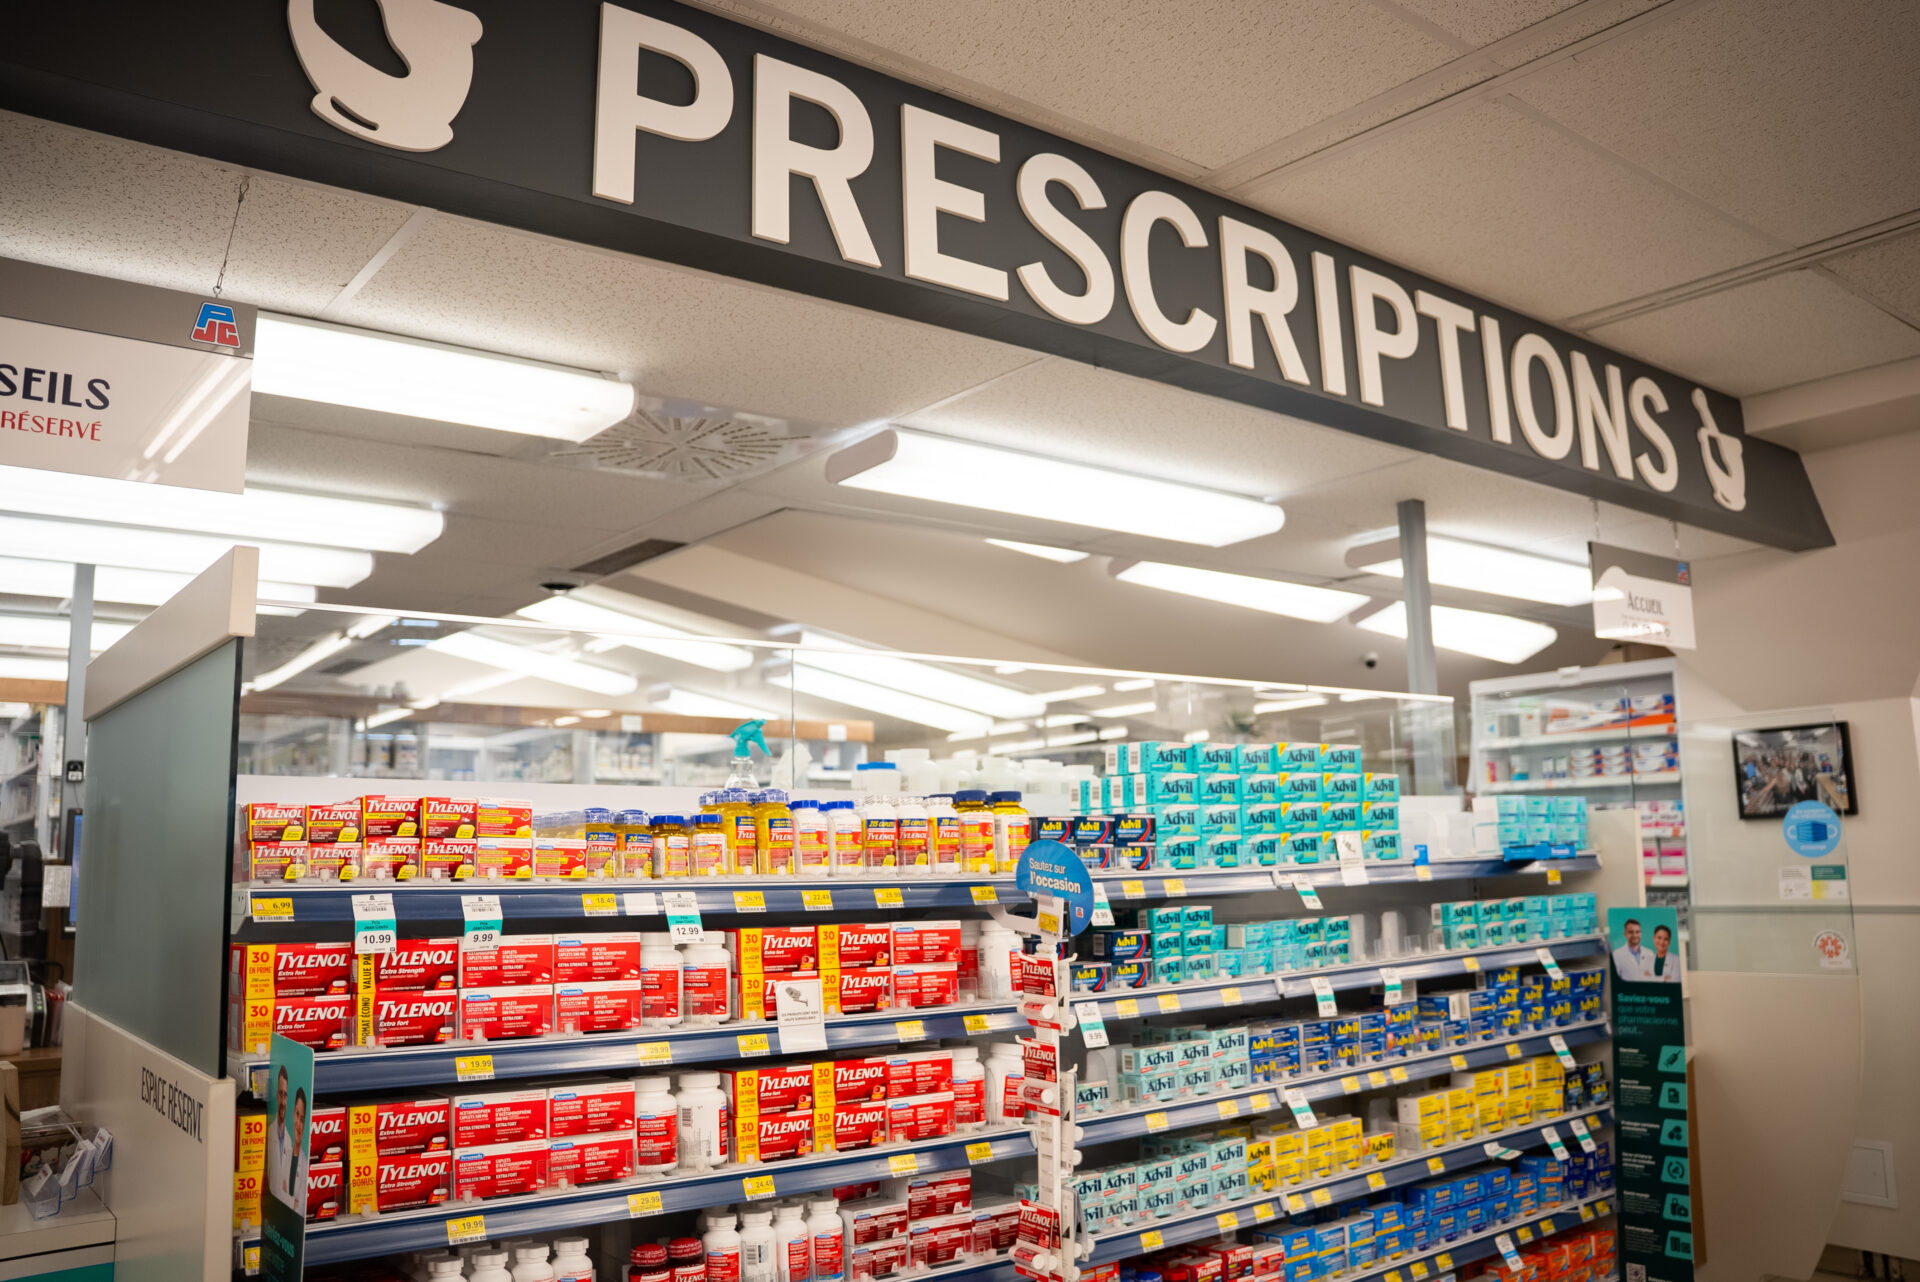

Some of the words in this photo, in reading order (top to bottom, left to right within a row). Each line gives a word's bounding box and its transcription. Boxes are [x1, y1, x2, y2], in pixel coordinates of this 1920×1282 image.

[592, 2, 1679, 494] PRESCRIPTIONS
[1, 410, 103, 442] RÉSERVÉ
[1157, 751, 1187, 763] Advil
[1203, 752, 1232, 763] Advil
[1244, 751, 1269, 763] Advil
[1287, 750, 1315, 762] Advil
[1328, 751, 1355, 763] Advil
[1162, 781, 1193, 793] Advil
[1207, 782, 1236, 794] Advil
[1248, 781, 1275, 793] Advil
[1289, 780, 1316, 792] Advil
[1332, 780, 1357, 792] Advil
[1372, 780, 1394, 792] Advil
[367, 800, 416, 813] TYLENOL
[429, 801, 474, 813] TYLENOL
[253, 806, 303, 820] TYLENOL
[310, 808, 358, 821] TYLENOL
[1164, 812, 1195, 825] Advil
[1207, 812, 1236, 824] Advil
[1248, 811, 1276, 823] Advil
[1291, 809, 1317, 821] Advil
[1330, 809, 1355, 821] Advil
[1370, 808, 1394, 820] Advil
[1041, 822, 1062, 831] Advil
[1079, 822, 1100, 831] Advil
[1119, 820, 1141, 829] Advil
[256, 845, 305, 858] TYLENOL
[312, 847, 359, 858] TYLENOL
[368, 843, 417, 855] TYLENOL
[426, 843, 474, 855] TYLENOL
[1029, 858, 1053, 872] Sautez
[1054, 865, 1066, 874] sur
[1030, 871, 1082, 893] l'occasion
[272, 901, 291, 910] 6.99
[676, 926, 699, 935] 12.99
[823, 931, 835, 940] 30
[363, 934, 391, 944] 10.99
[473, 933, 493, 943] 9.99
[745, 934, 758, 944] 30
[763, 935, 813, 949] TYLENOL
[840, 932, 888, 946] TYLENOL
[1115, 936, 1137, 947] Advil
[252, 951, 270, 963] 30
[277, 952, 347, 971] TYLENOL
[380, 950, 454, 968] TYLENOL
[257, 966, 271, 974] PRIME
[398, 967, 425, 975] Strength
[1021, 961, 1052, 976] TYLENOL
[1075, 968, 1097, 979] Advil
[1117, 964, 1138, 975] Advil
[363, 967, 372, 990] VALUE
[746, 980, 759, 989] 30
[824, 975, 836, 984] 30
[841, 975, 889, 990] TYLENOL
[250, 1005, 268, 1017] 30
[276, 1005, 347, 1024] TYLENOL
[378, 1001, 453, 1020] TYLENOL
[749, 1038, 768, 1046] 24.49
[1216, 1030, 1245, 1049] Advil
[1251, 1037, 1275, 1050] Advil
[650, 1046, 669, 1054] 29.99
[1025, 1045, 1055, 1062] TYLENOL
[1181, 1045, 1209, 1060] Advil
[1144, 1050, 1174, 1065] Advil
[471, 1060, 492, 1068] 19.99
[818, 1069, 829, 1078] 30
[835, 1067, 884, 1083] TYLENOL
[741, 1077, 753, 1087] 30
[759, 1075, 811, 1092] TYLENOL
[141, 1066, 166, 1117] ESPACE
[1077, 1087, 1109, 1102] Advil
[354, 1113, 371, 1124] 30
[378, 1110, 445, 1130] TYLENOL
[818, 1113, 830, 1123] 30
[835, 1111, 884, 1127] TYLENOL
[245, 1122, 262, 1135] 30
[741, 1123, 754, 1132] 30
[760, 1120, 811, 1137] TYLENOL
[242, 1138, 249, 1146] EN
[249, 1137, 264, 1145] PRIME
[1215, 1146, 1243, 1162] Advil
[355, 1166, 371, 1177] 30
[1179, 1158, 1207, 1174] Advil
[379, 1162, 447, 1183] TYLENOL
[1144, 1166, 1173, 1183] Advil
[238, 1178, 256, 1190] 30
[352, 1178, 374, 1187] BONUS
[756, 1180, 774, 1189] 24.49
[1075, 1180, 1102, 1195] dvil
[1105, 1173, 1136, 1190] Advil
[235, 1191, 258, 1200] BONUS
[641, 1196, 660, 1206] 29.99
[1020, 1210, 1050, 1228] TYLENOL
[462, 1221, 484, 1231] 19.99
